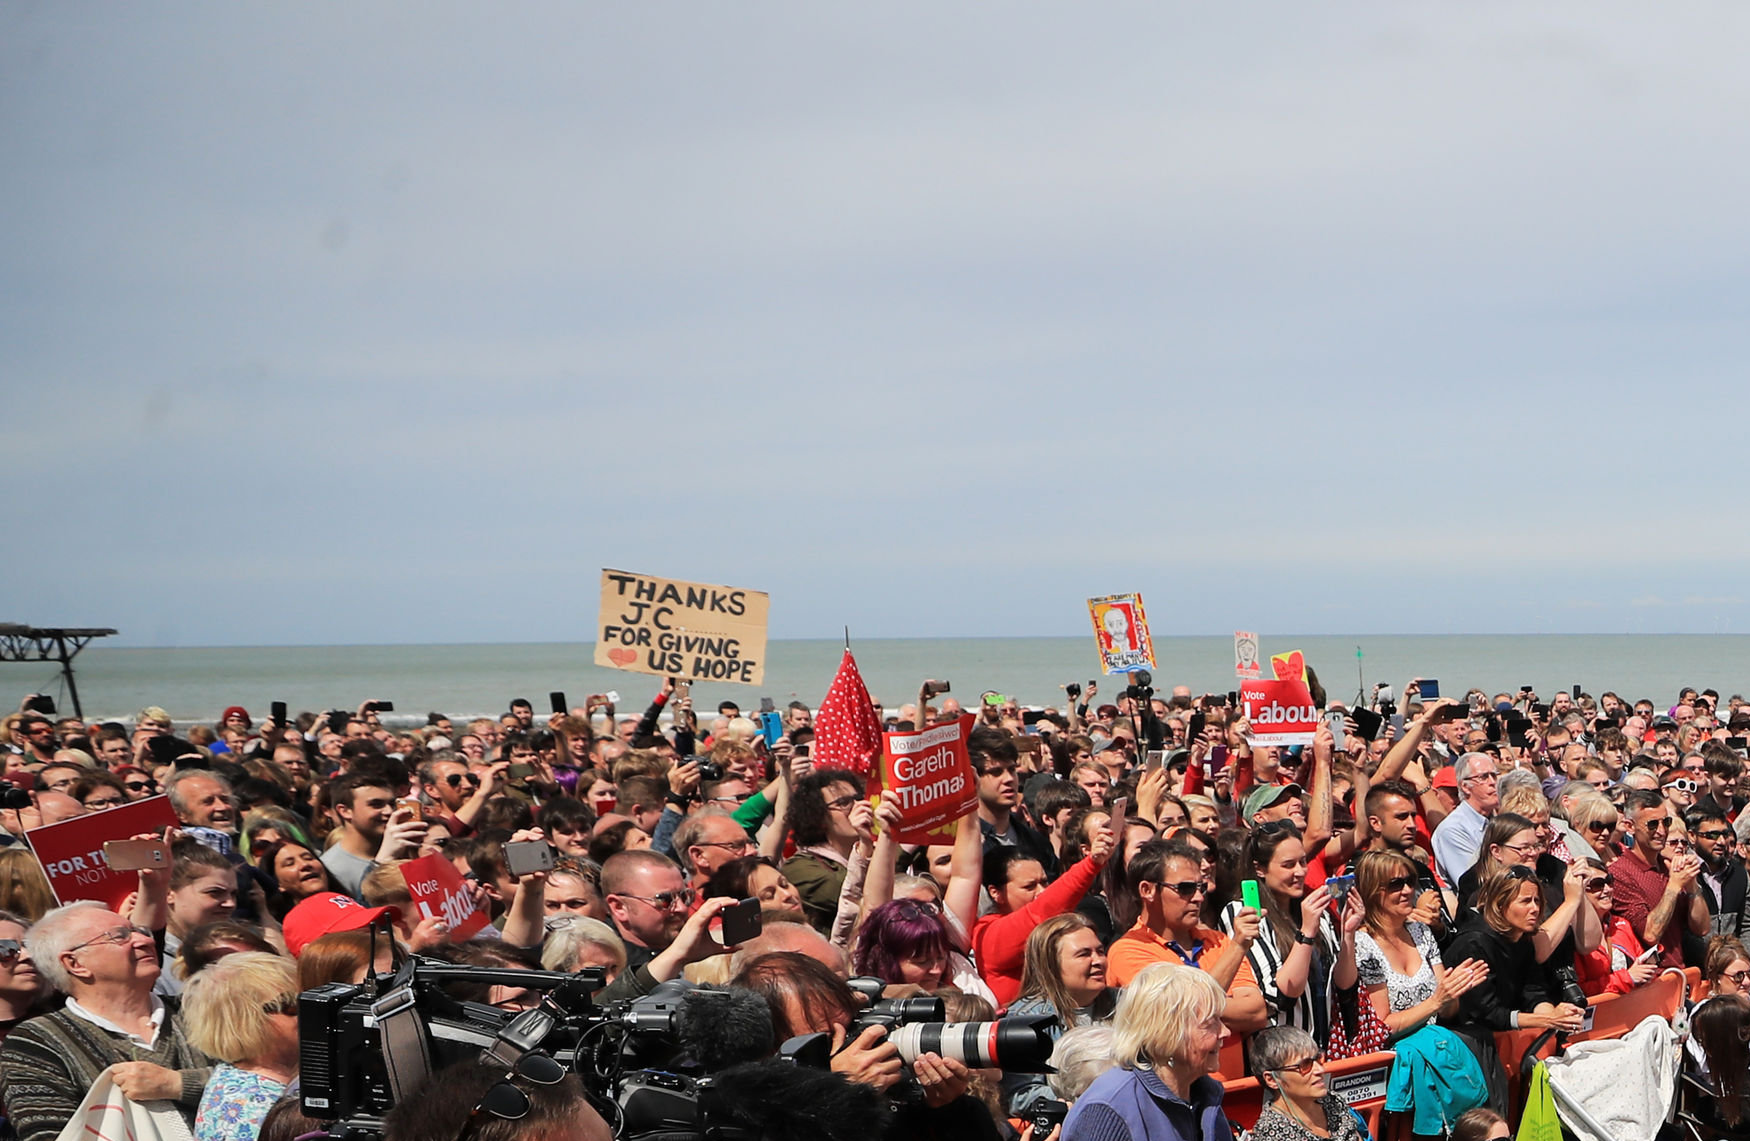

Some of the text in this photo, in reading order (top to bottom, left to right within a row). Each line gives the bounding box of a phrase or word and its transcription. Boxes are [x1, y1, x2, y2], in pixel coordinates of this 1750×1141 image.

[608, 574, 745, 615] THANKS
[604, 625, 740, 659] FOR GIVING
[647, 650, 756, 683] US HOPE
[1244, 691, 1265, 700] Vote
[894, 746, 954, 781] Gareth
[895, 772, 965, 809] Thomas
[46, 856, 88, 879] FOR
[75, 866, 107, 886] NOT
[410, 880, 439, 896] Vote
[1335, 1075, 1372, 1089] BRANDON
